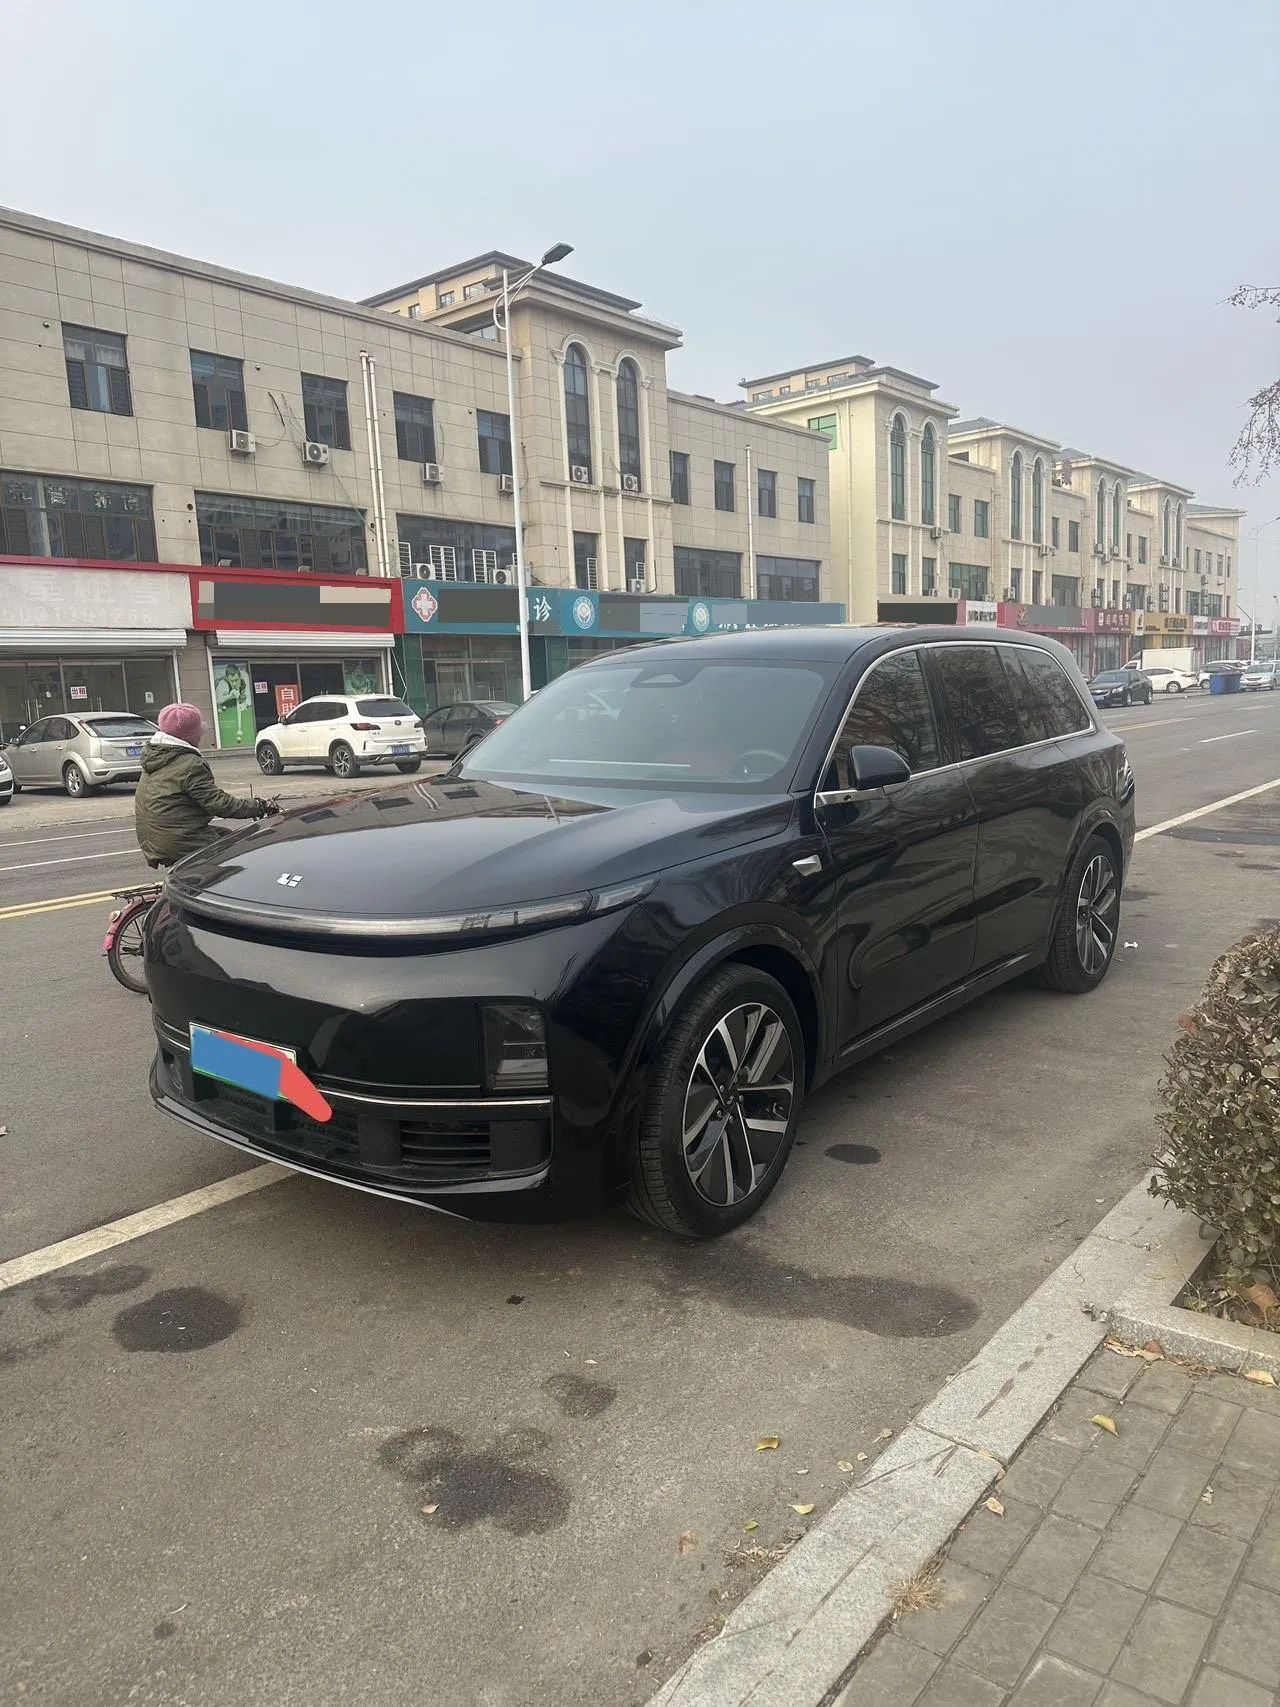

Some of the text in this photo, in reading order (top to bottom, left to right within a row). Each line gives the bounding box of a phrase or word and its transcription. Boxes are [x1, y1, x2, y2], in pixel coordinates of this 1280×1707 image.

[533, 596, 554, 622] 诊
[71, 687, 86, 695] 出租
[281, 688, 296, 714] 自助
